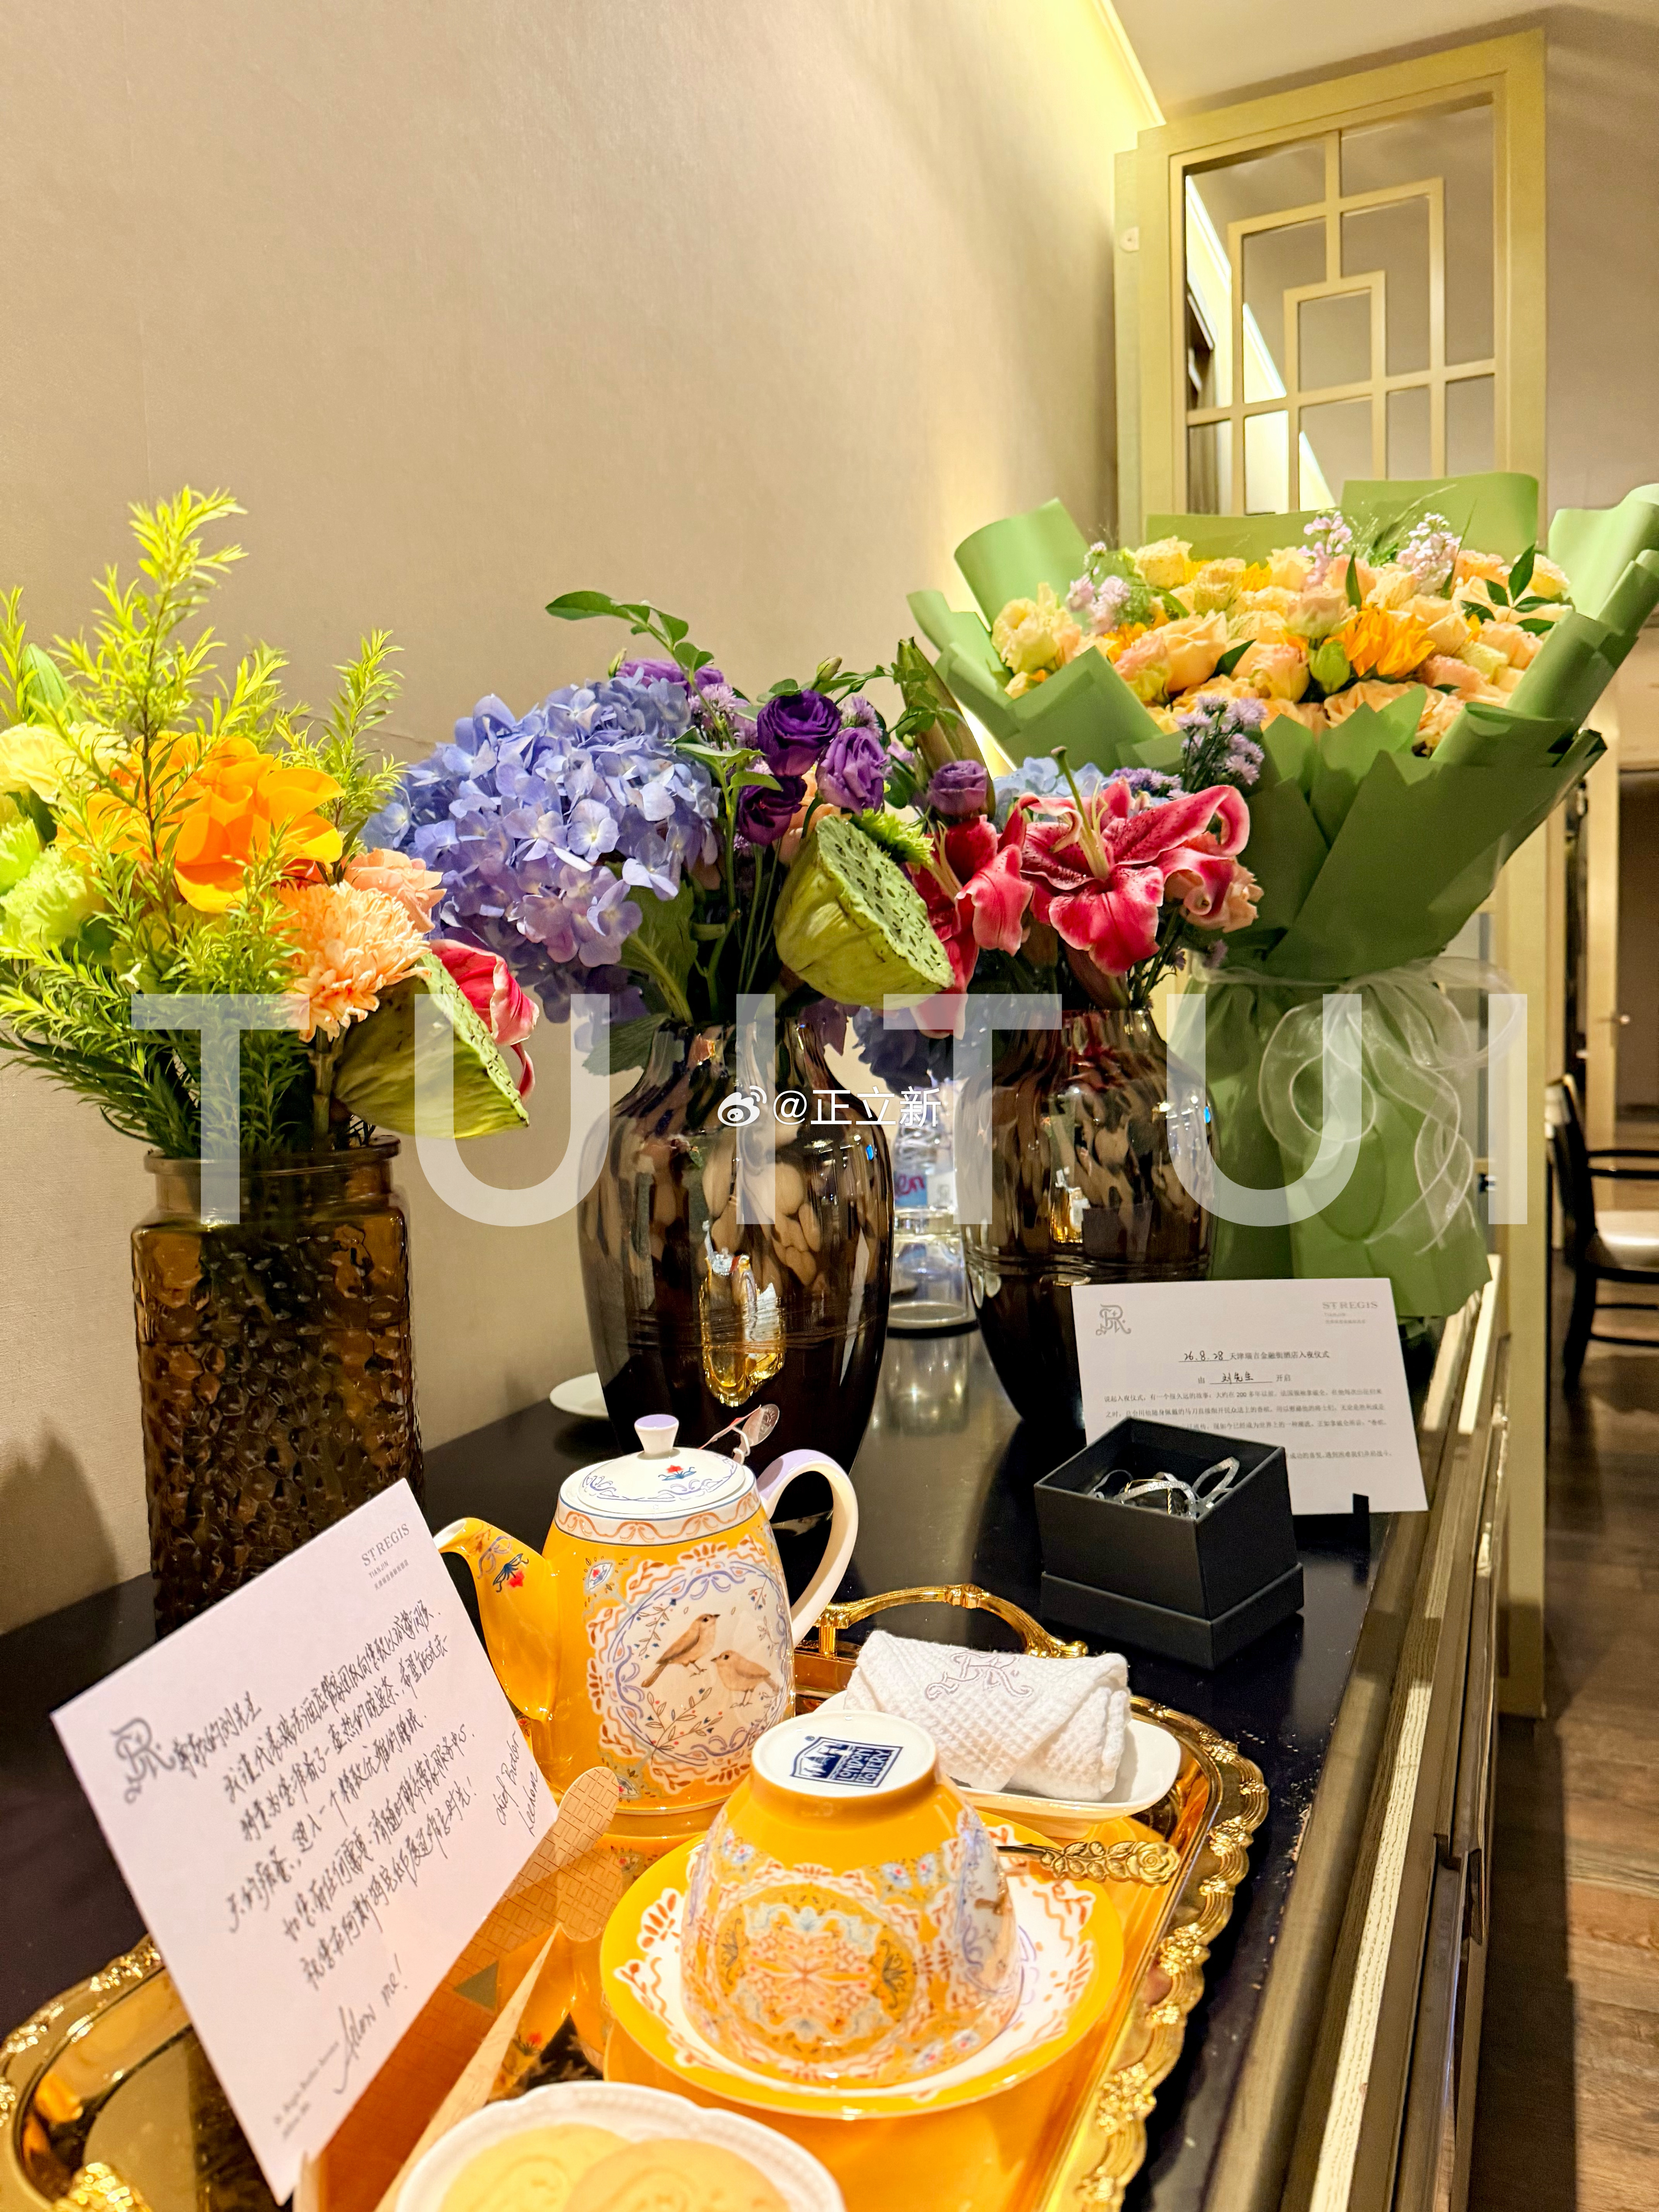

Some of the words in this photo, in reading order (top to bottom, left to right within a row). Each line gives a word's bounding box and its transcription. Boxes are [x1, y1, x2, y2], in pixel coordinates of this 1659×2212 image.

[1222, 1371, 1254, 1384] 刘先生
[376, 1524, 409, 1555] REGIS
[369, 1561, 388, 1578] TIANJIN
[173, 1691, 261, 1777] 尊敬的刘先生
[837, 1748, 874, 1781] LONDON
[855, 1750, 890, 1783] POTTERY
